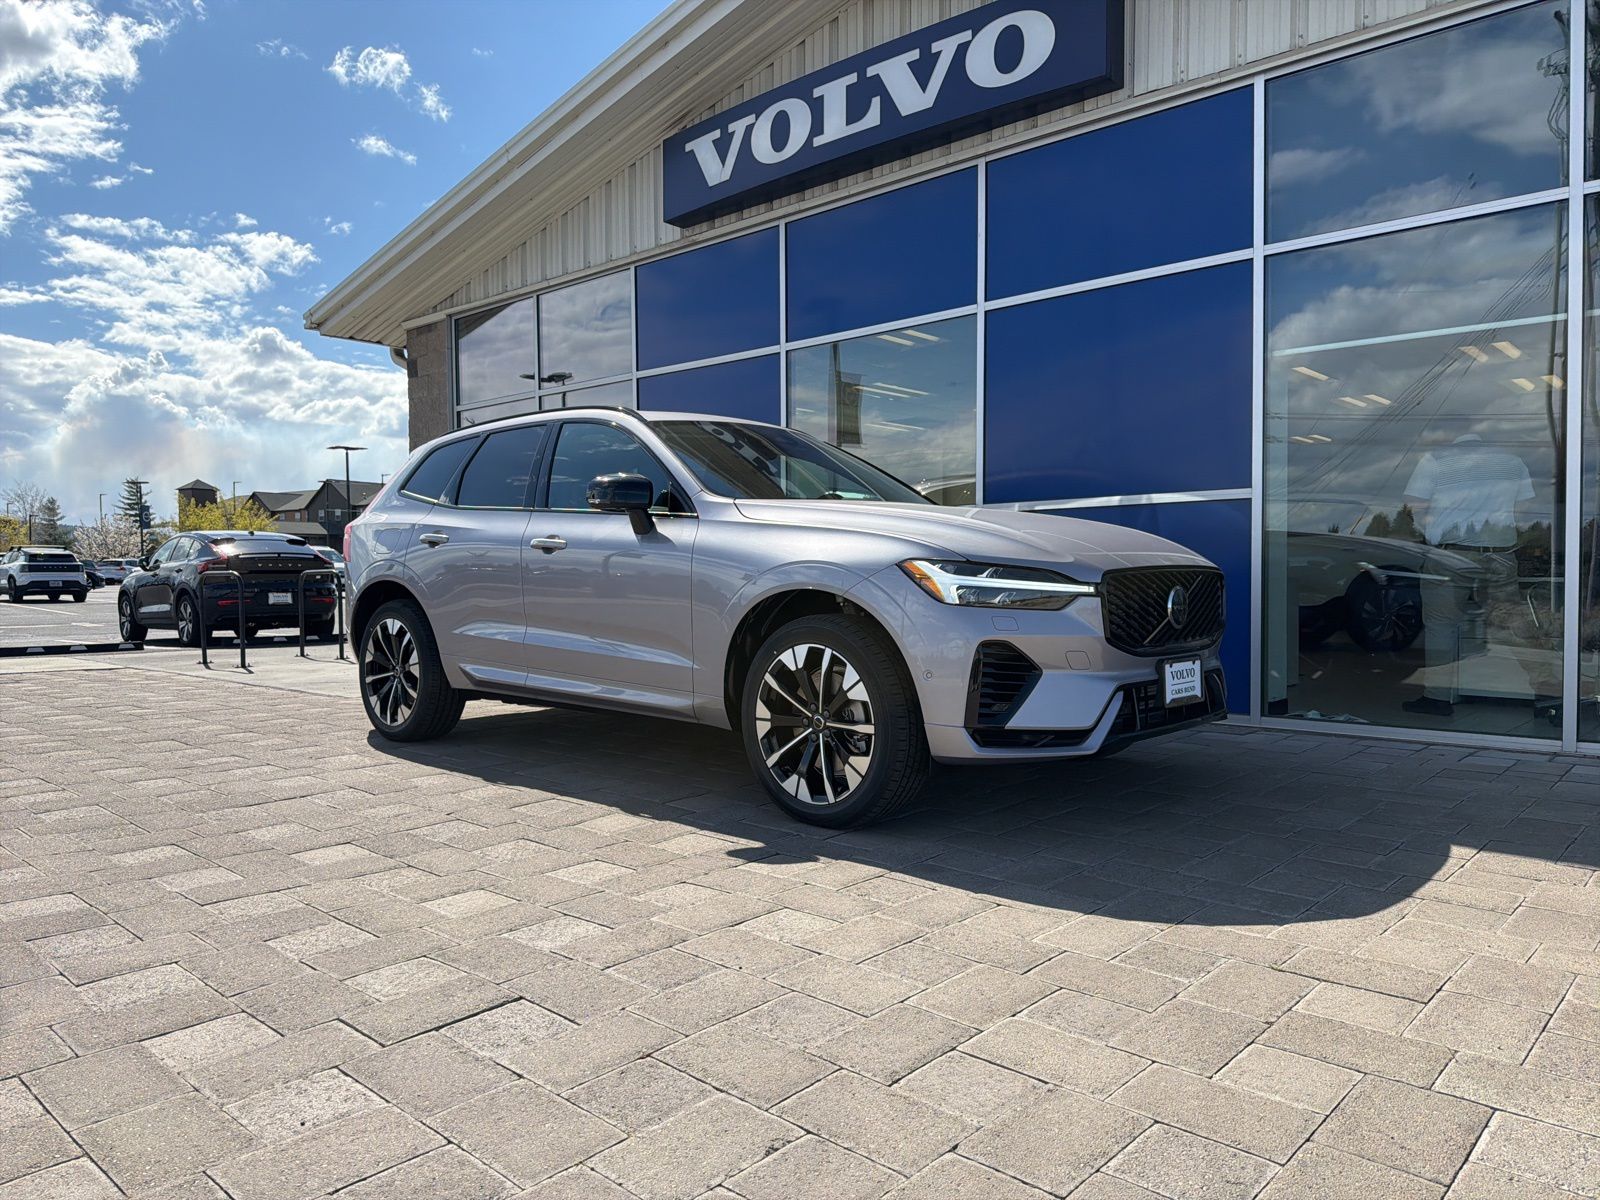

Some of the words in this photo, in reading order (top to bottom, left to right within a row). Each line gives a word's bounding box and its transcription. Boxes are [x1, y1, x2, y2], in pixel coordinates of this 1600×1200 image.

[685, 10, 1056, 188] VOLVO
[1171, 667, 1195, 680] VOLVO
[1171, 687, 1184, 696] CARS
[1184, 685, 1196, 694] BEND
